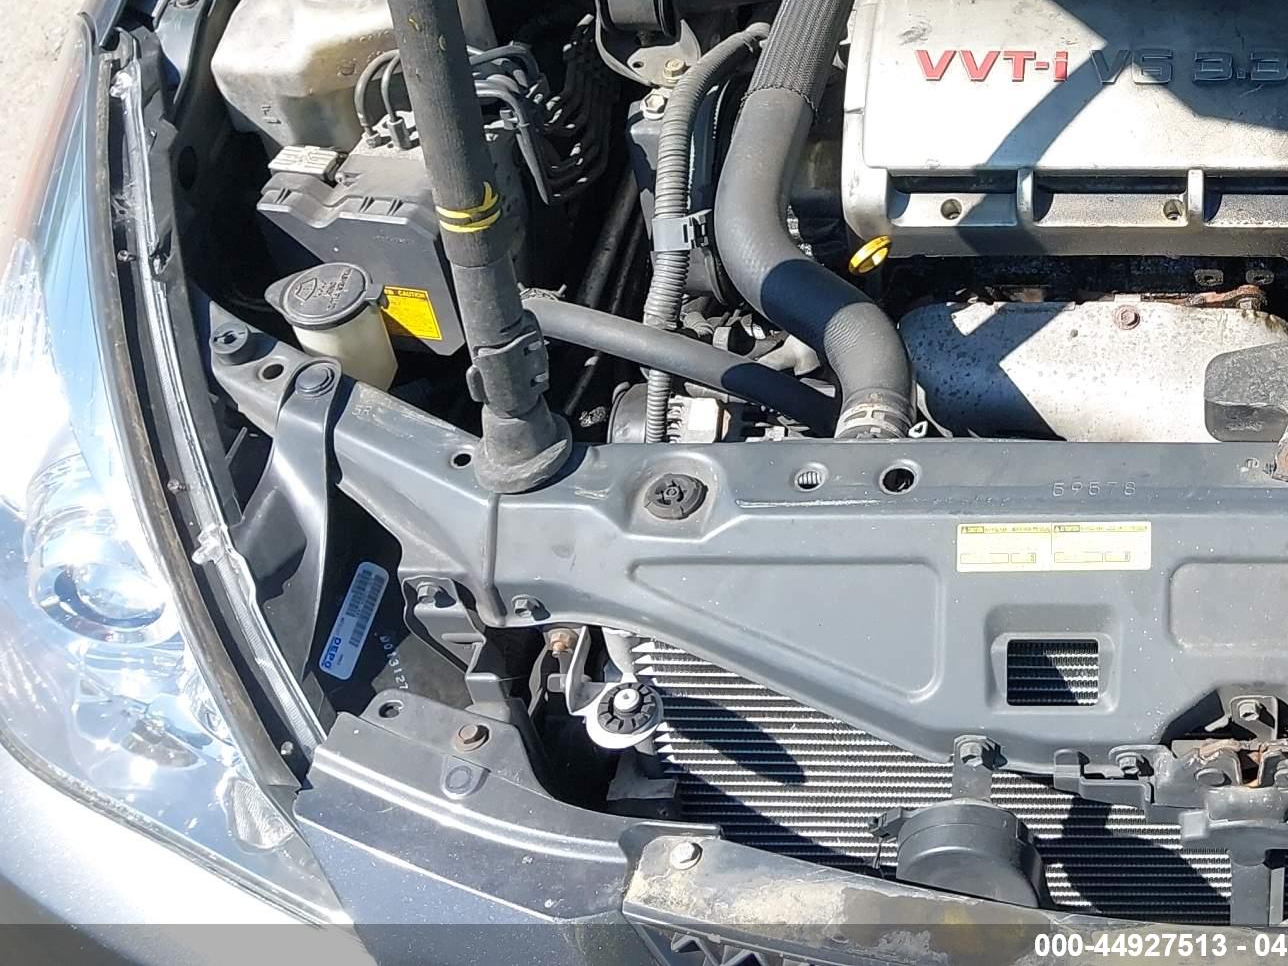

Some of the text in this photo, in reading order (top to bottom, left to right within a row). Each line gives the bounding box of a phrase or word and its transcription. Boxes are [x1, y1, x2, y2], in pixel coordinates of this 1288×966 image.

[915, 49, 1069, 83] VVT-i
[1090, 49, 1174, 84] V6
[324, 636, 342, 669] DEPO
